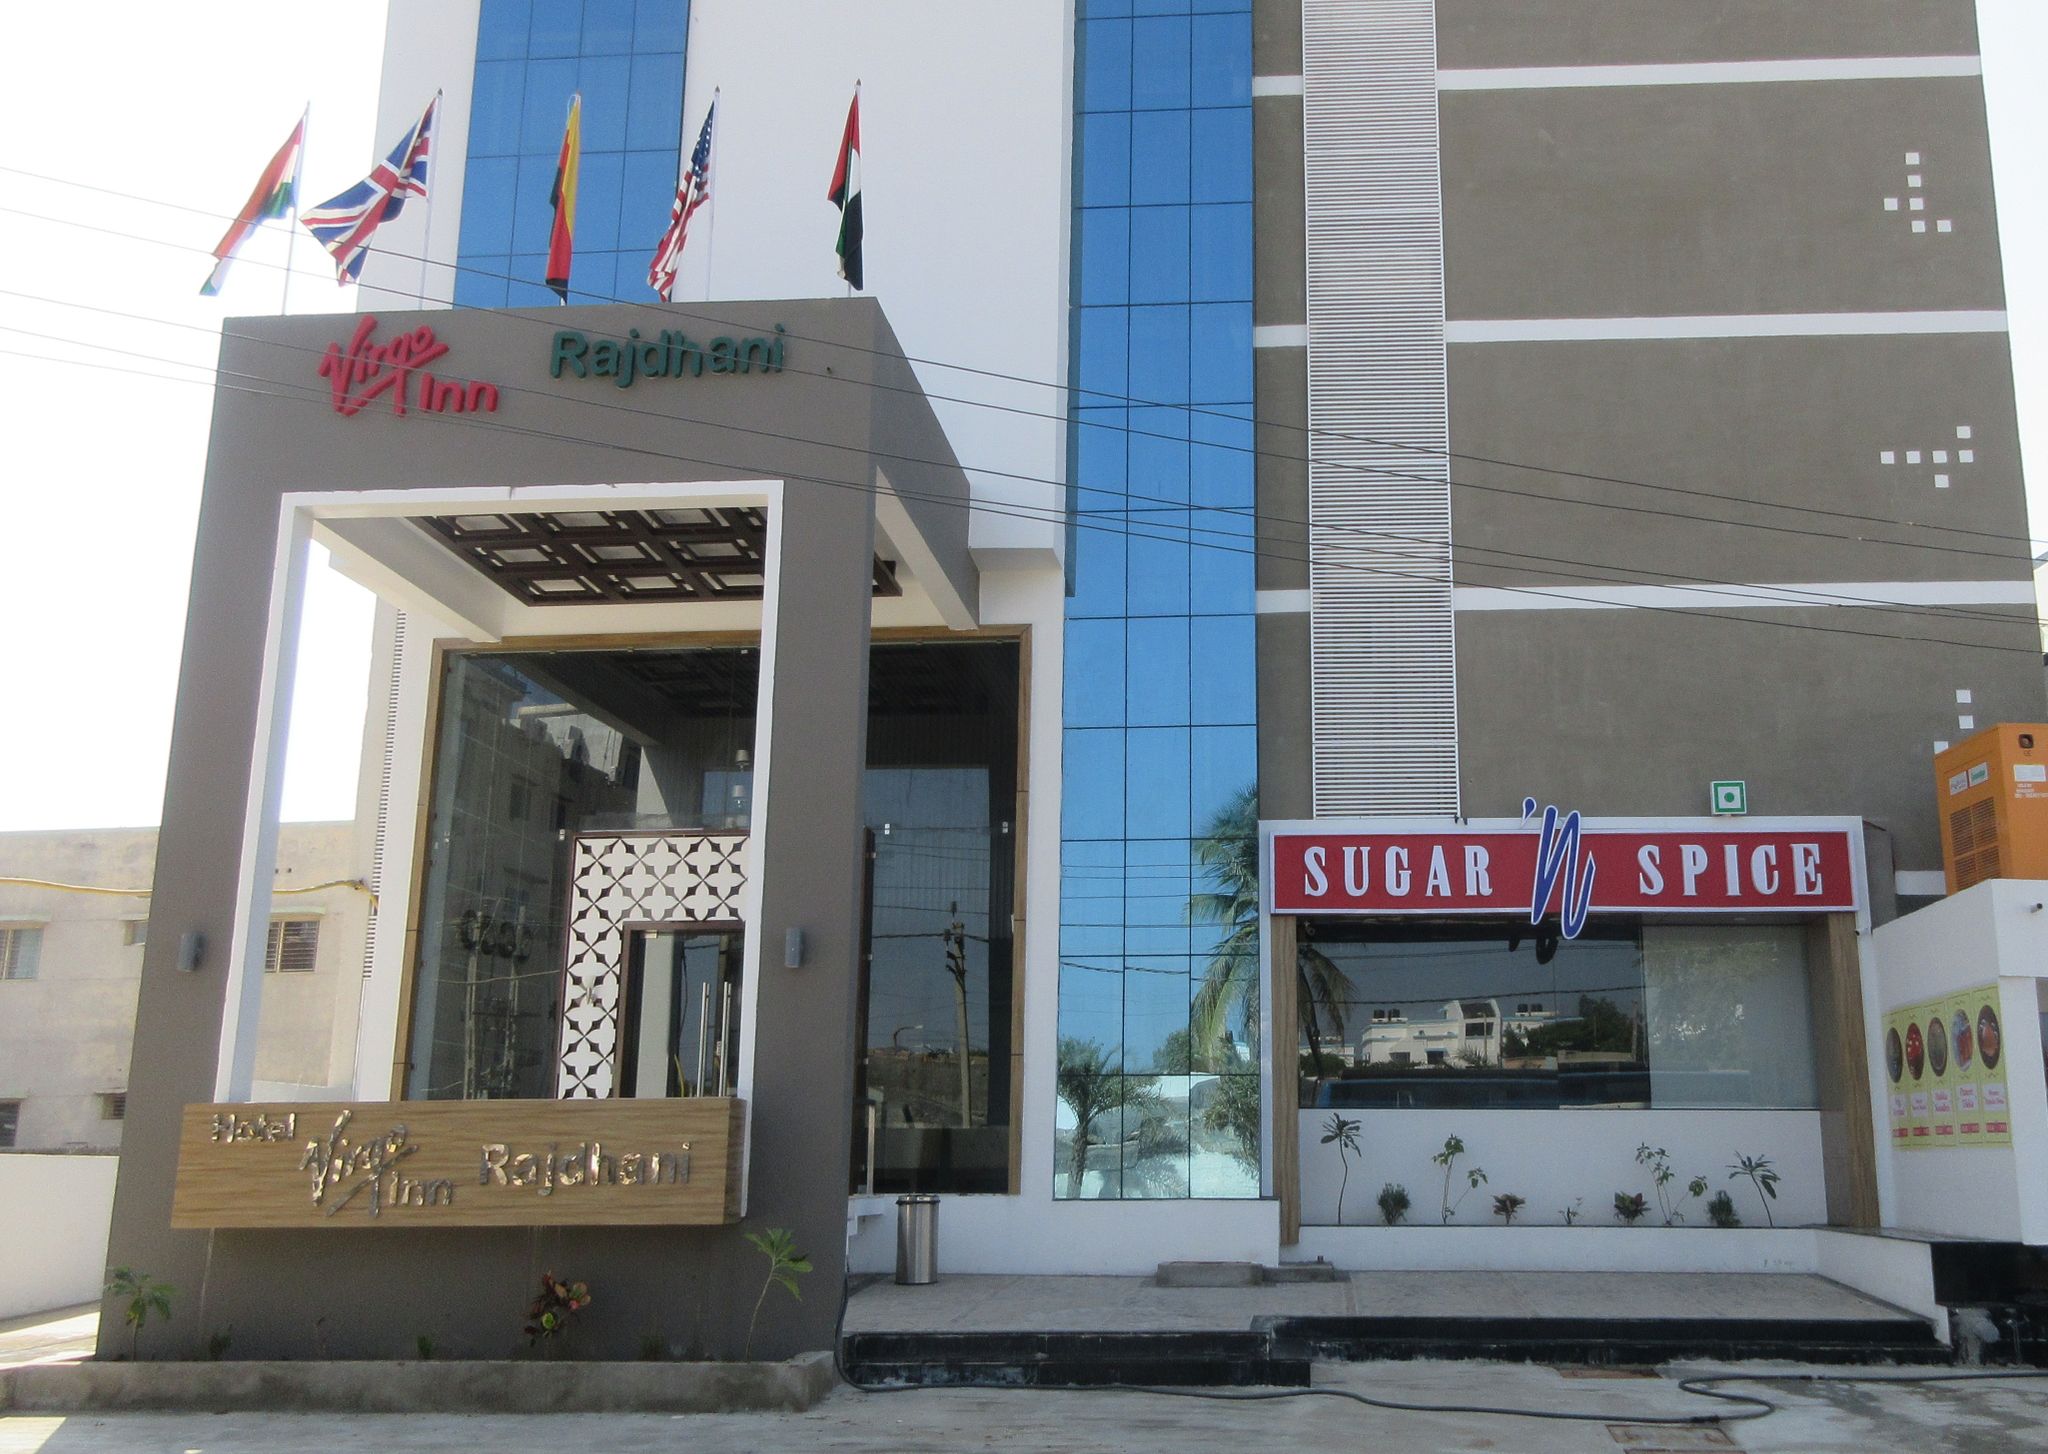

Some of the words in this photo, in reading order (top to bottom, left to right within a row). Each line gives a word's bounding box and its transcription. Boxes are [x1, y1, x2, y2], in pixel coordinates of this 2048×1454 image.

[318, 315, 450, 417] Virgo
[420, 372, 498, 413] Inn
[551, 323, 785, 388] Rajdhani
[1303, 845, 1493, 897] SUGAR
[1637, 843, 1823, 896] SPICE
[211, 1112, 296, 1143] Hotel
[300, 1109, 418, 1217] Virgo
[480, 1141, 691, 1196] Rajdhani
